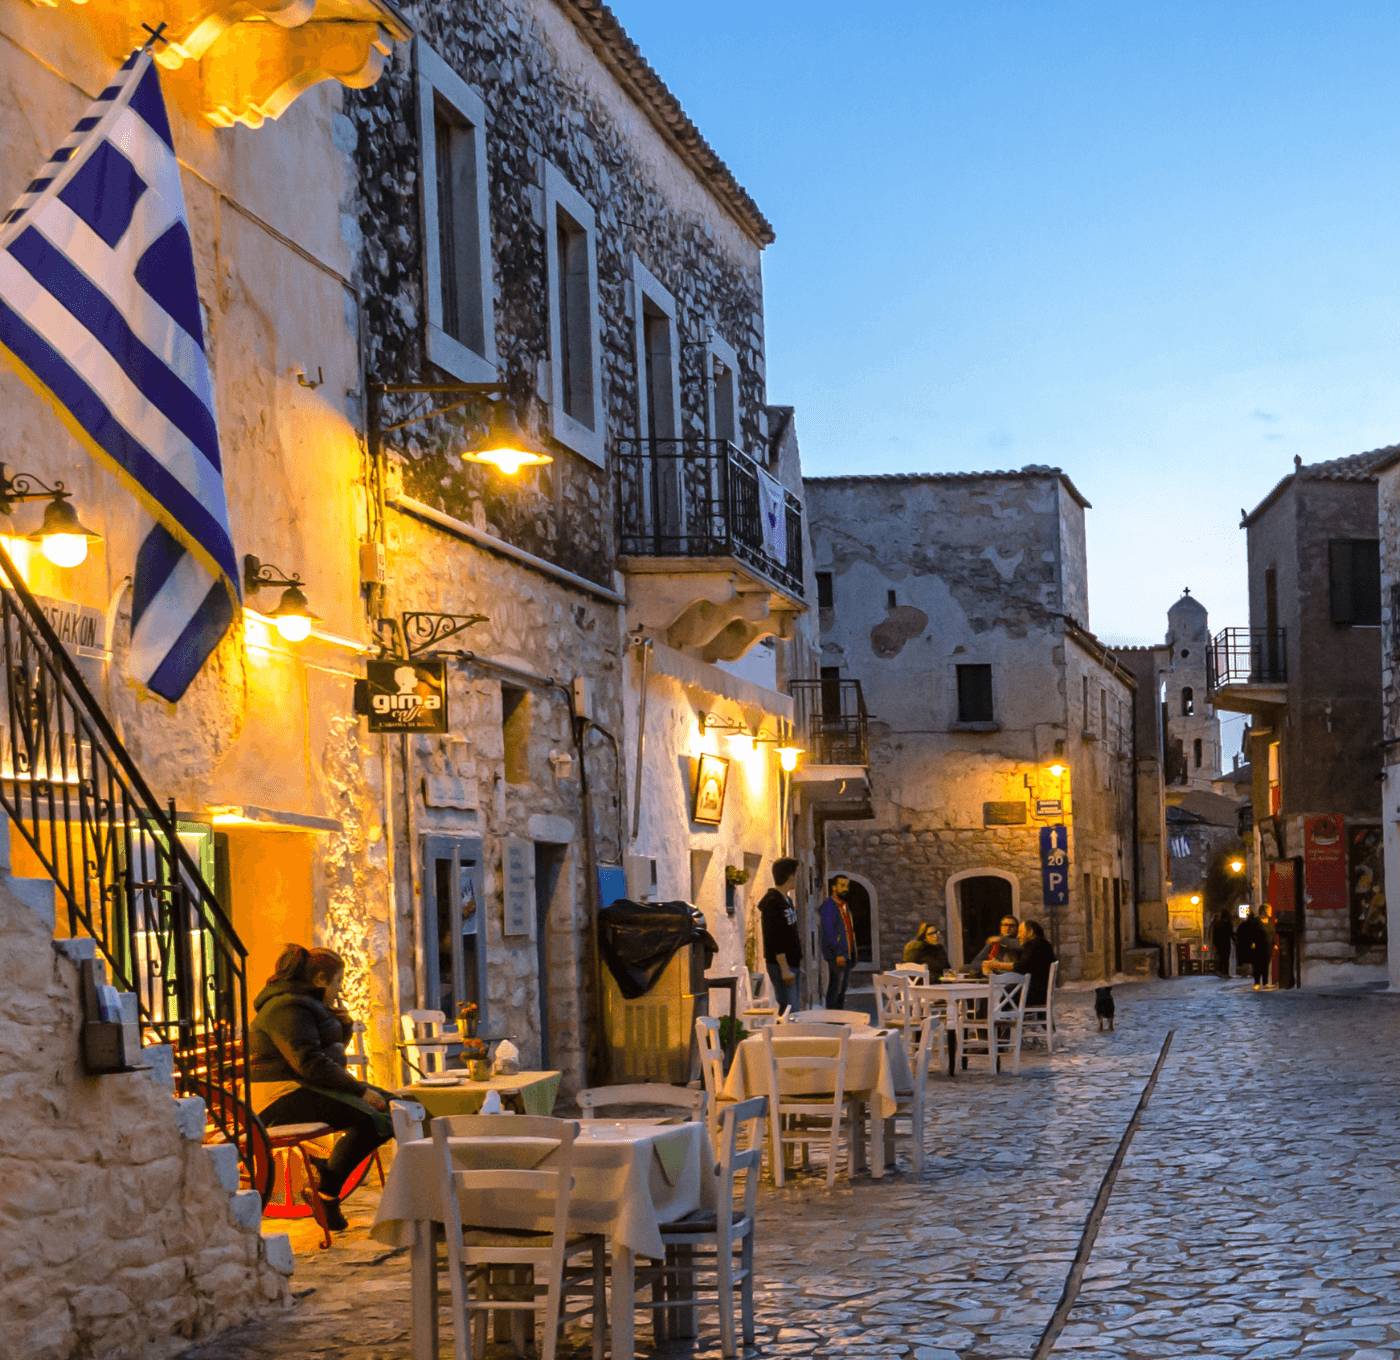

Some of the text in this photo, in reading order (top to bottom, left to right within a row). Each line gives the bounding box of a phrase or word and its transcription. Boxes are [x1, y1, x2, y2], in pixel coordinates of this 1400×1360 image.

[373, 694, 440, 714] gima
[1047, 855, 1064, 866] 20
[1049, 872, 1063, 891] P
